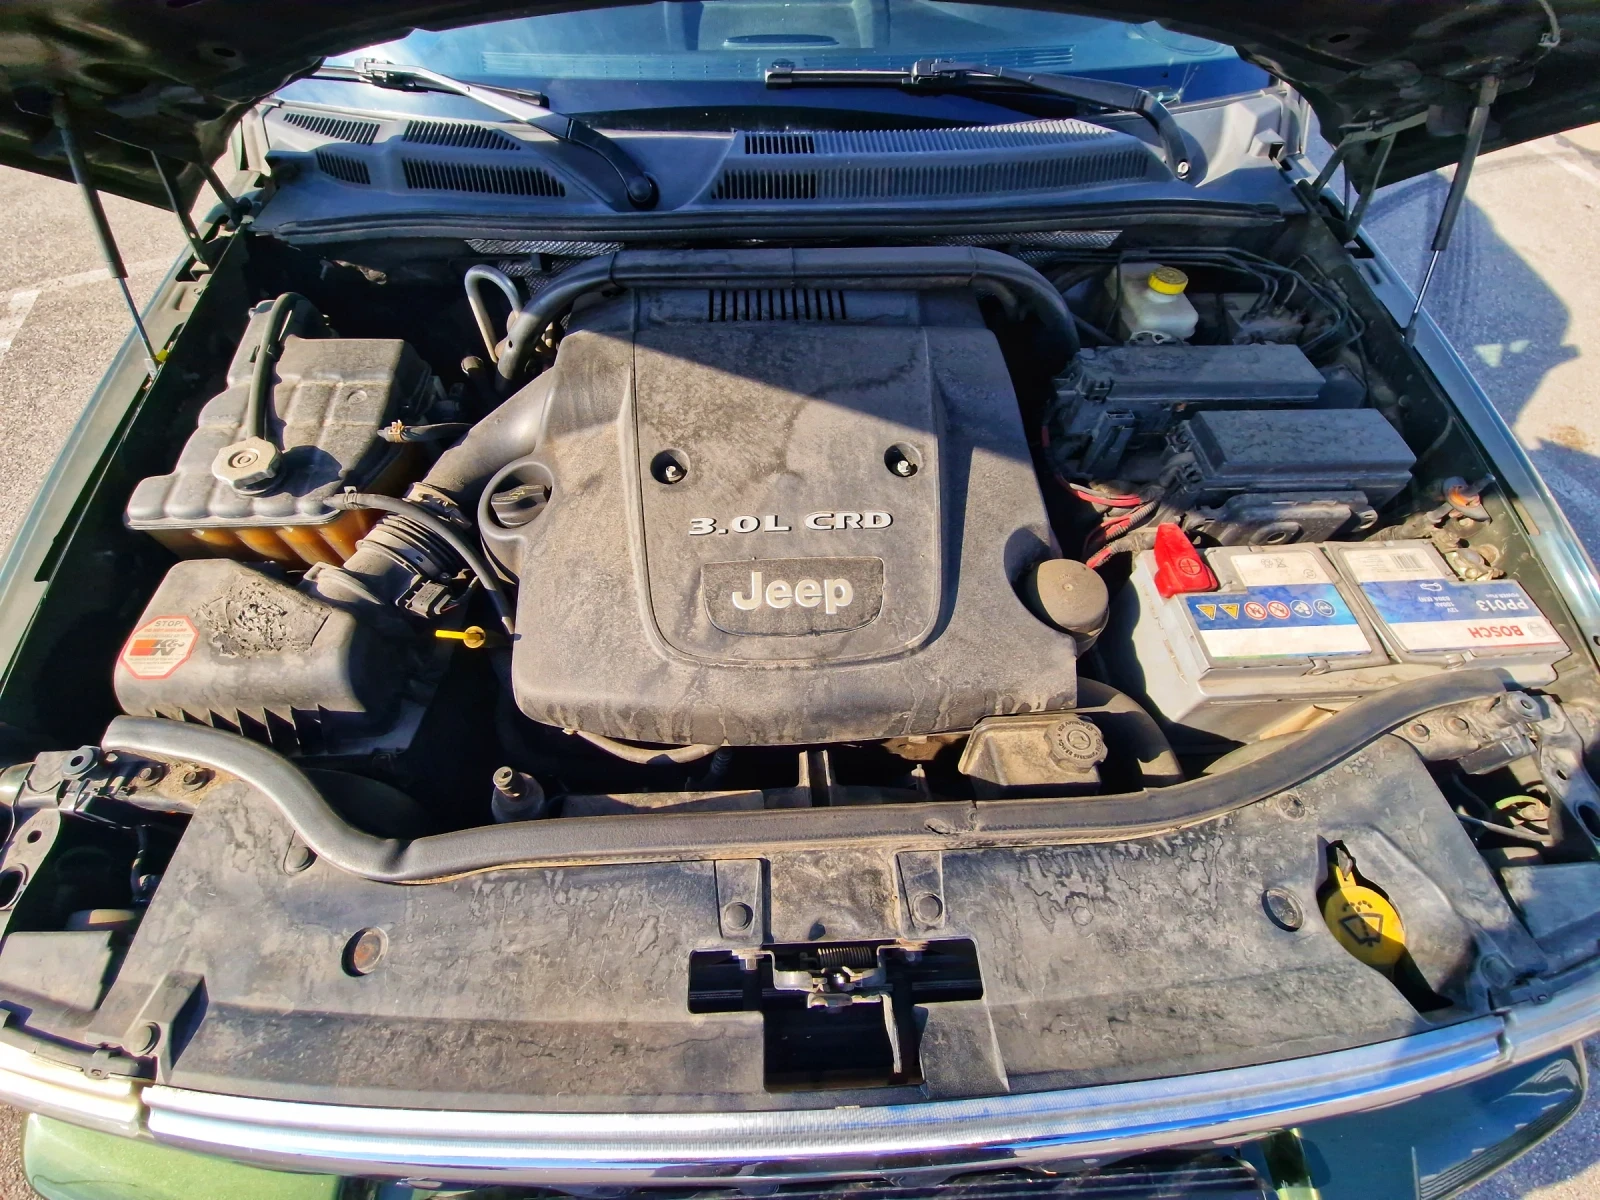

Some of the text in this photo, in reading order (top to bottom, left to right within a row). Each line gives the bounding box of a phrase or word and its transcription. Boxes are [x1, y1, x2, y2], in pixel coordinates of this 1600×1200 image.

[688, 511, 893, 536] 3.0L CRD
[732, 571, 854, 615] Jeep
[1476, 599, 1529, 612] PP013
[1468, 625, 1525, 638] BOSCH
